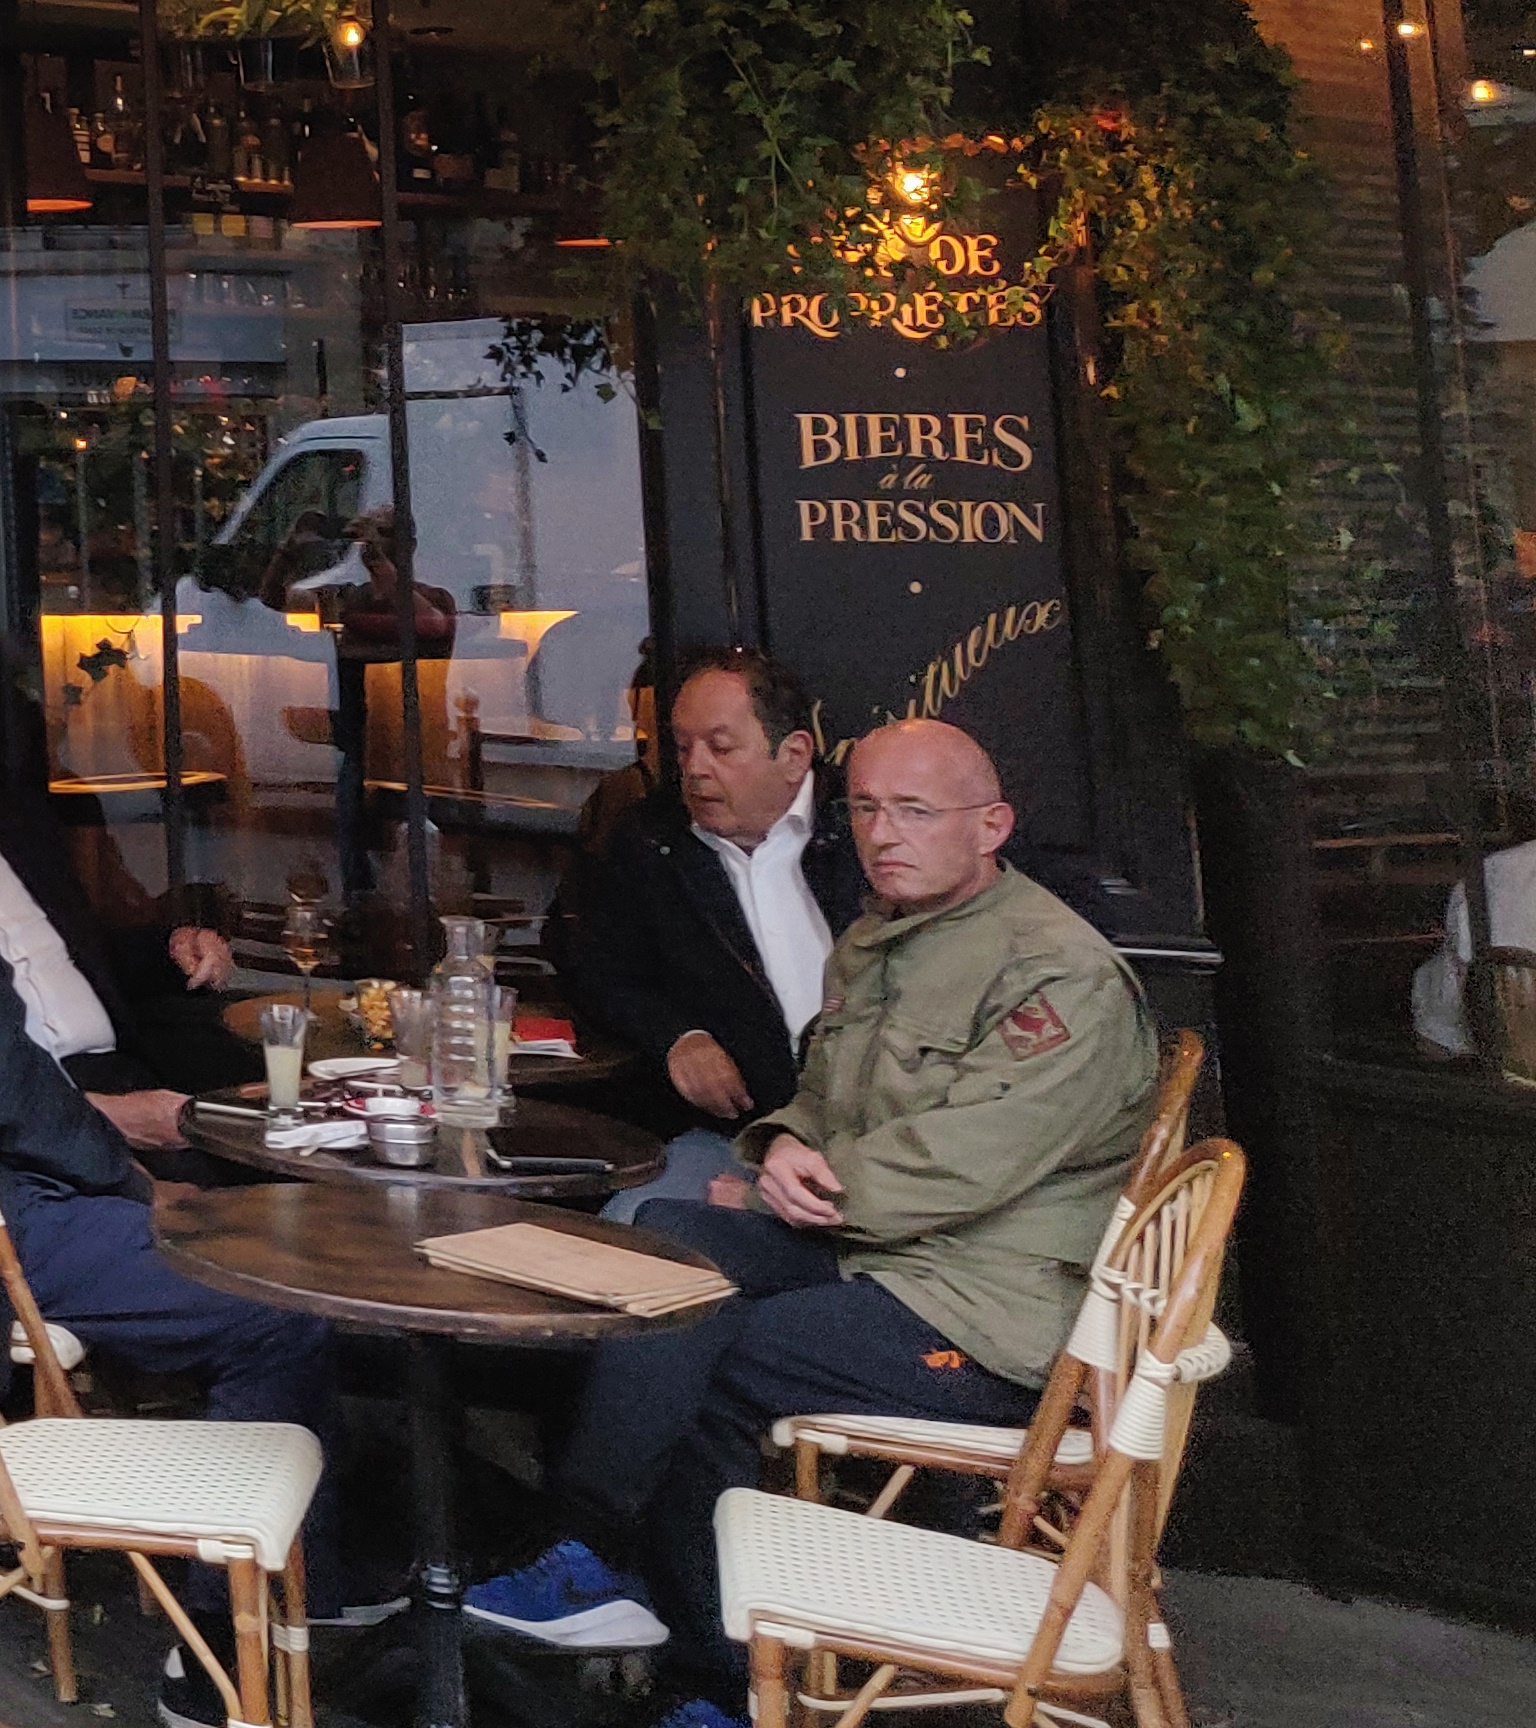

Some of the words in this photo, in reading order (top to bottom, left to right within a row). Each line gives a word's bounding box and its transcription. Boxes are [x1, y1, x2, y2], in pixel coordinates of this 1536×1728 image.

[929, 233, 1002, 276] DE
[793, 412, 1034, 472] BIERES
[903, 463, 934, 490] la
[794, 499, 1048, 544] PRESSION
